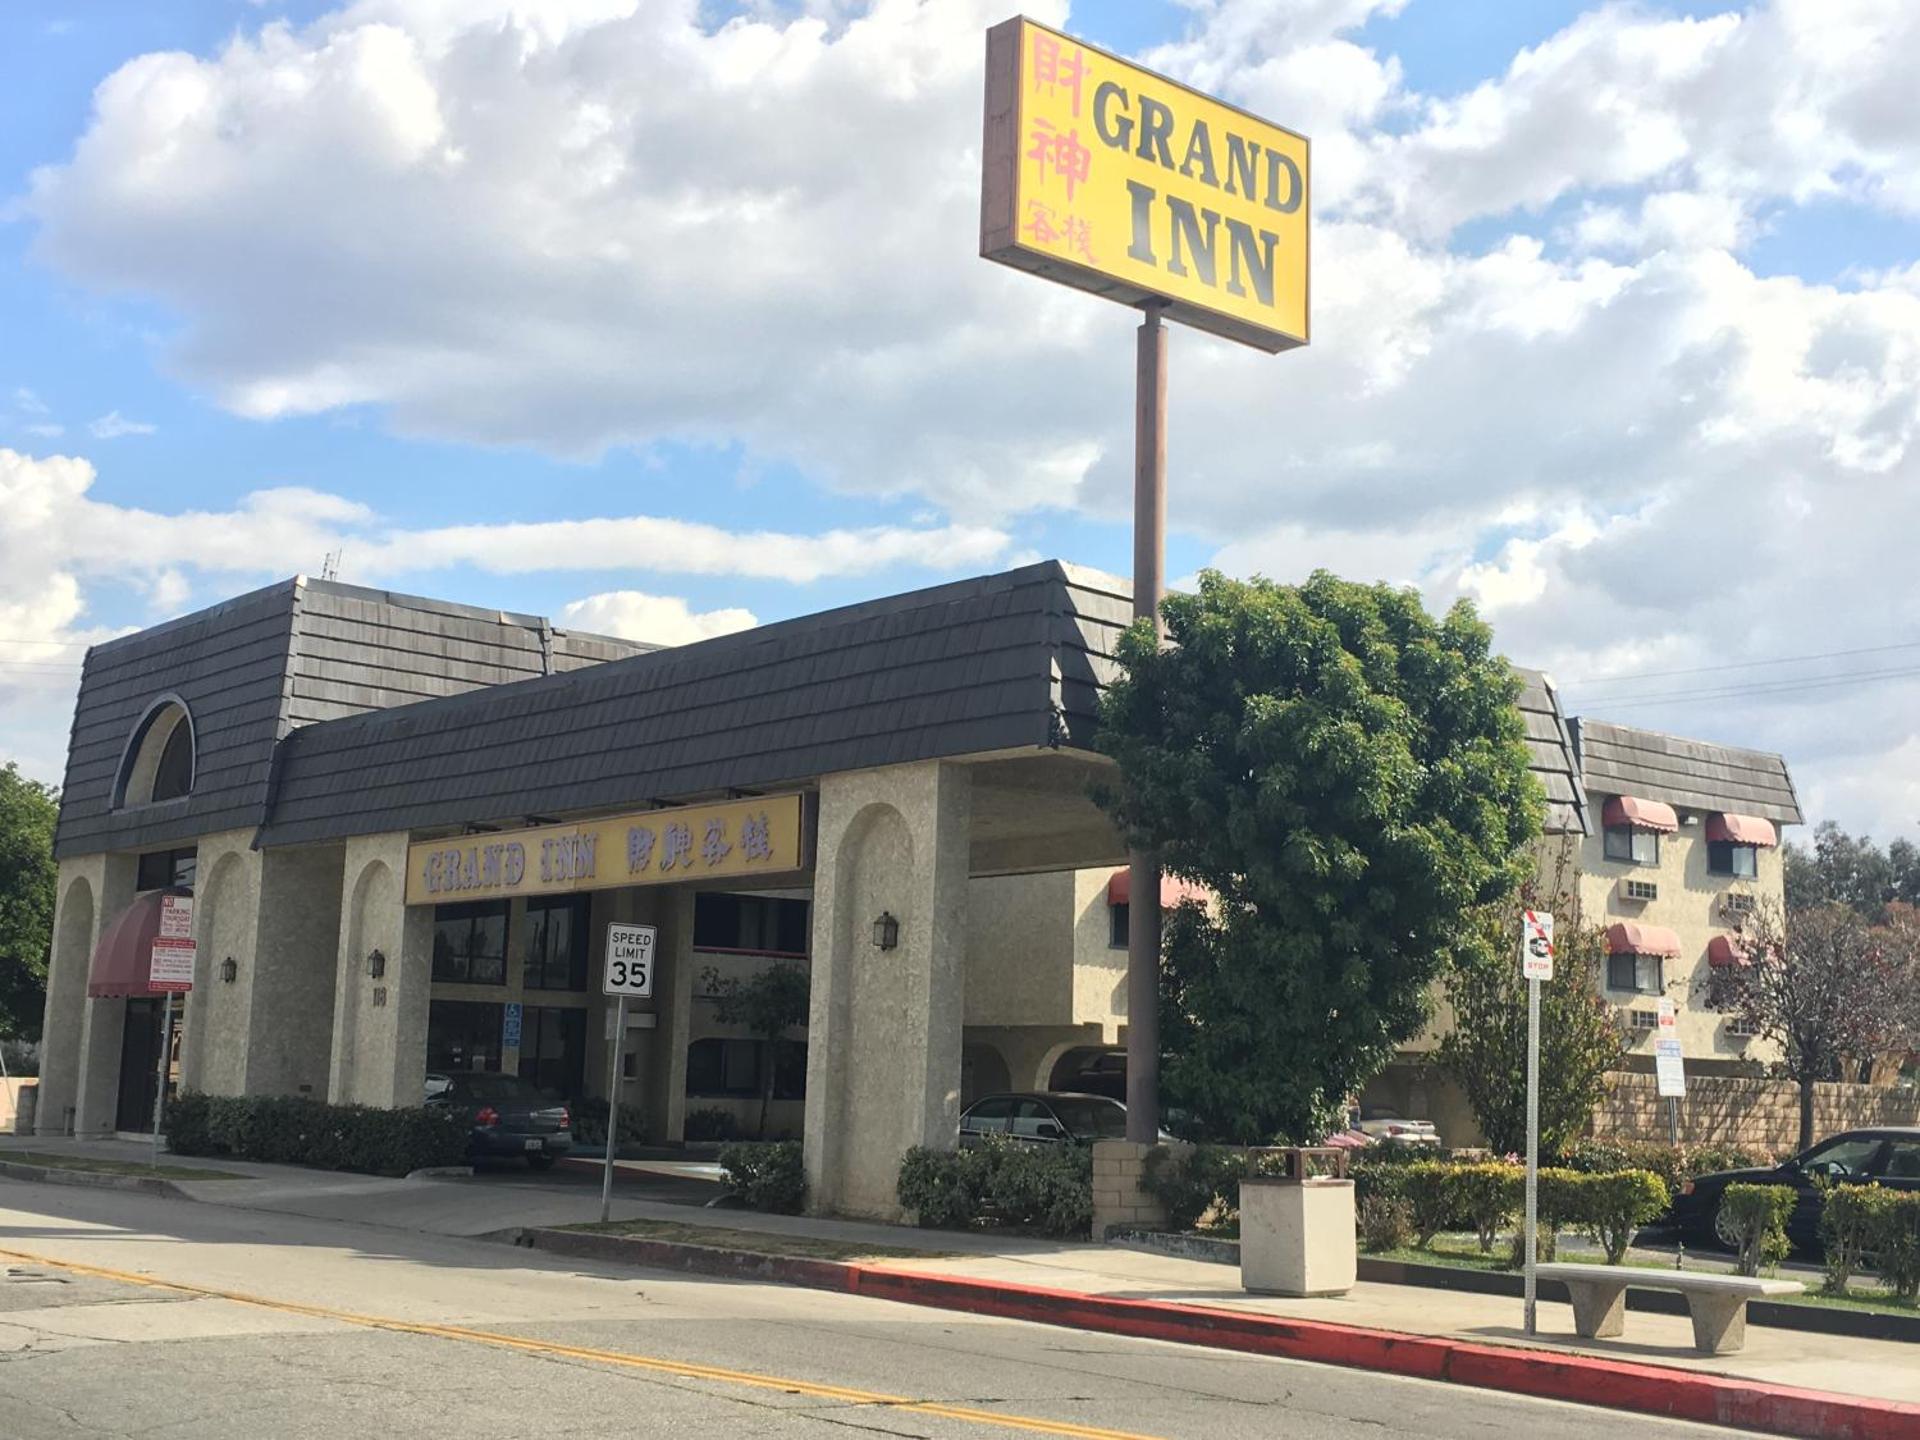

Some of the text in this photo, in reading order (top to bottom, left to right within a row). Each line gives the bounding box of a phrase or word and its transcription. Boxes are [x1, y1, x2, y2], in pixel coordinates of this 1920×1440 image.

[1092, 80, 1303, 214] GRAND
[1126, 178, 1280, 308] INN
[423, 841, 525, 892] GRAND
[539, 831, 596, 882] INN
[612, 932, 651, 945] SPEED
[615, 946, 646, 959] LIMIT
[611, 961, 646, 987] 35
